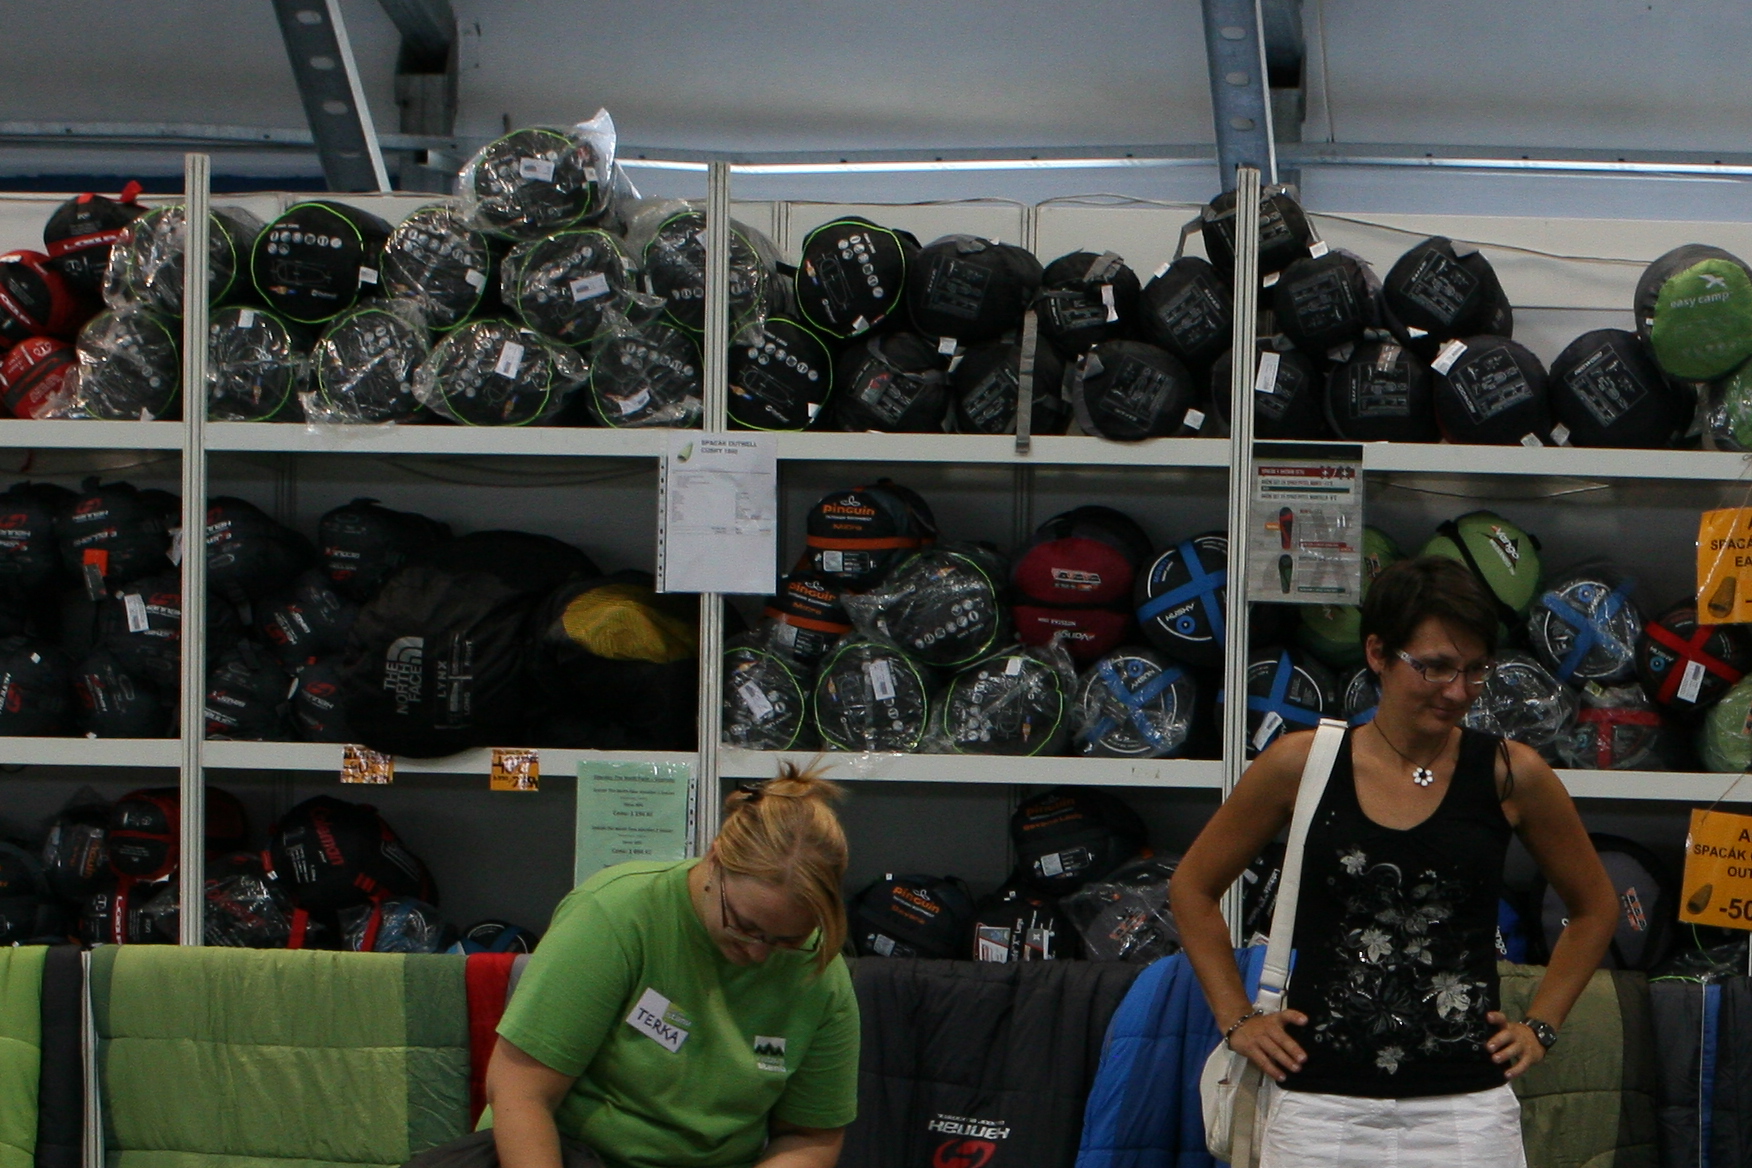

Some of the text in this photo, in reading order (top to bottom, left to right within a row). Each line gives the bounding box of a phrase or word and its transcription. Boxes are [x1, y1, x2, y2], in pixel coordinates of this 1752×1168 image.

[1670, 292, 1730, 309] easy camp
[823, 503, 875, 517] pinguin
[383, 661, 398, 690] THE
[395, 661, 409, 716] NORTH
[408, 665, 422, 704] FACE
[437, 660, 448, 699] LYNX
[1693, 843, 1747, 861] SPACÁK
[637, 1007, 678, 1045] TERKA
